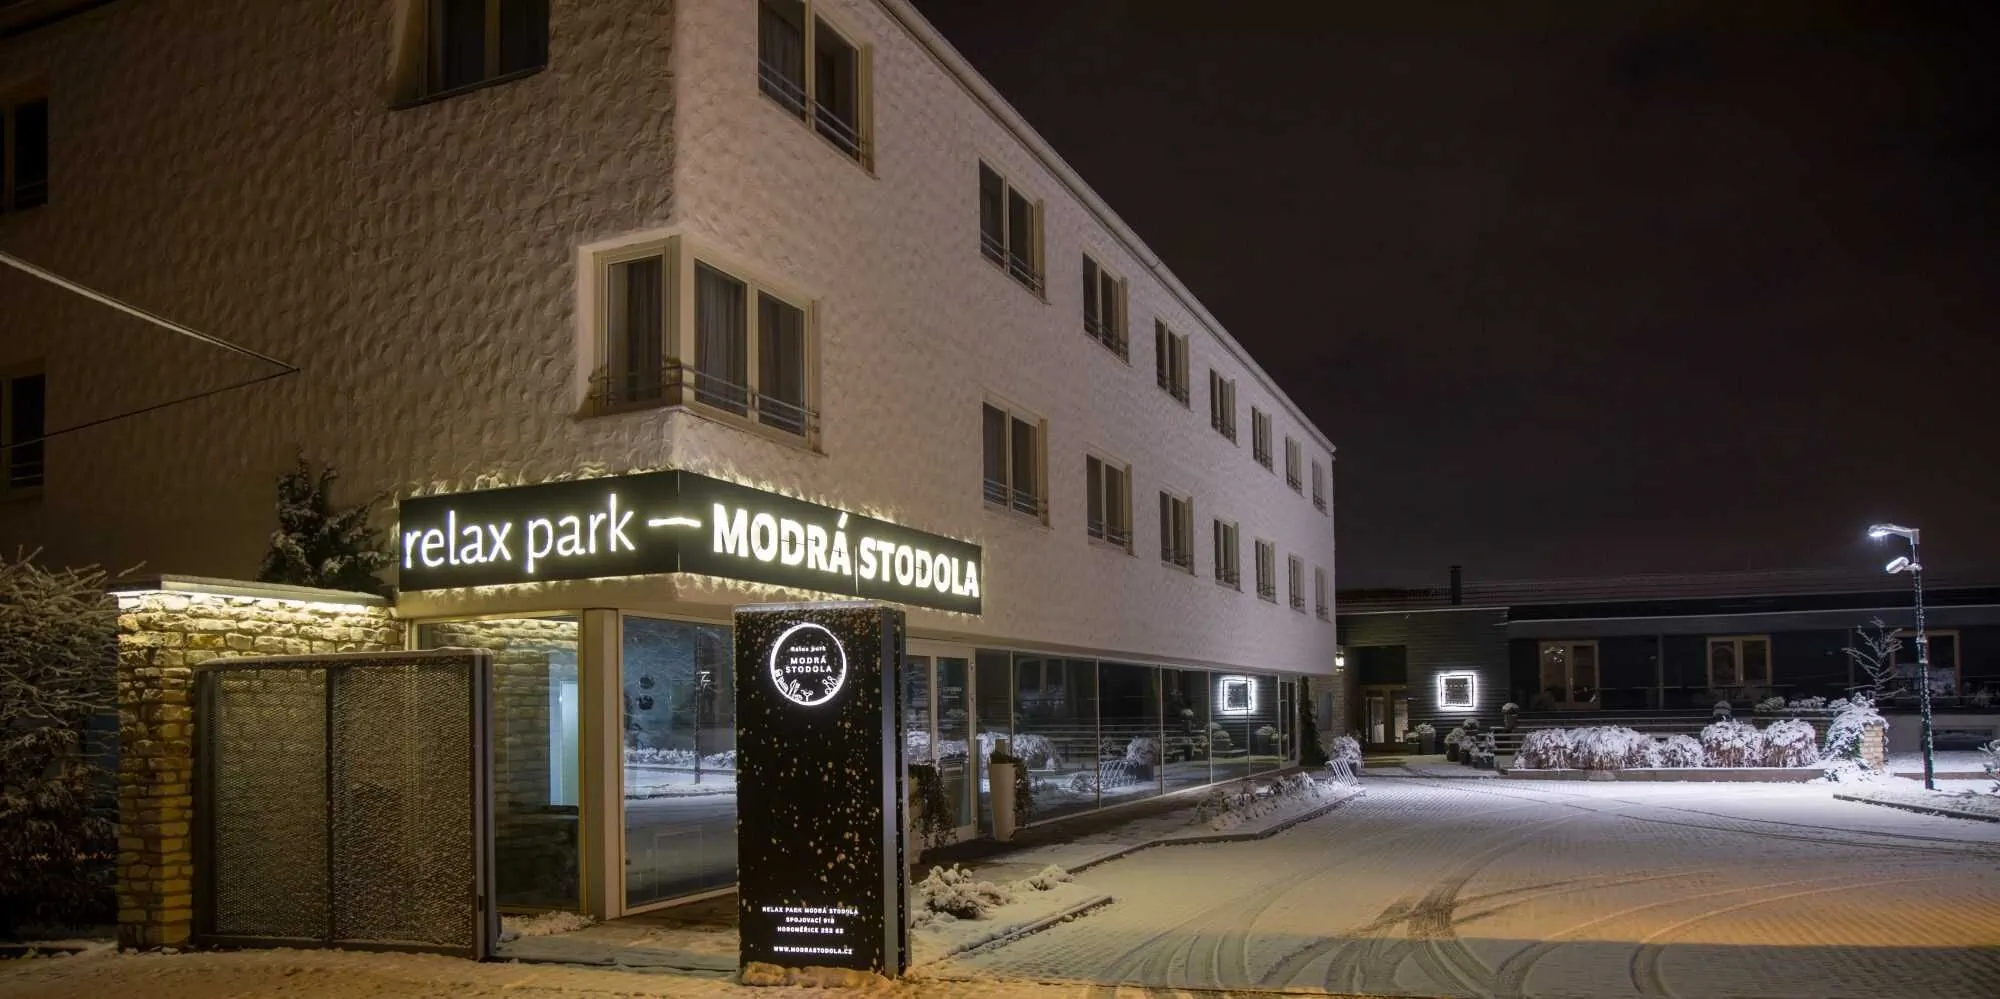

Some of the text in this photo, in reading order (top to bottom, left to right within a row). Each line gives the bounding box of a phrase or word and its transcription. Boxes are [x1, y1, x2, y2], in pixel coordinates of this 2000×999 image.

[404, 510, 512, 568] relax
[526, 493, 635, 573] park
[713, 511, 851, 575] MODRÁ
[859, 536, 979, 598] STODOLA
[790, 655, 827, 664] MODRÁ
[785, 665, 832, 673] STODOLA
[786, 916, 821, 924] SPOJOVACÍ
